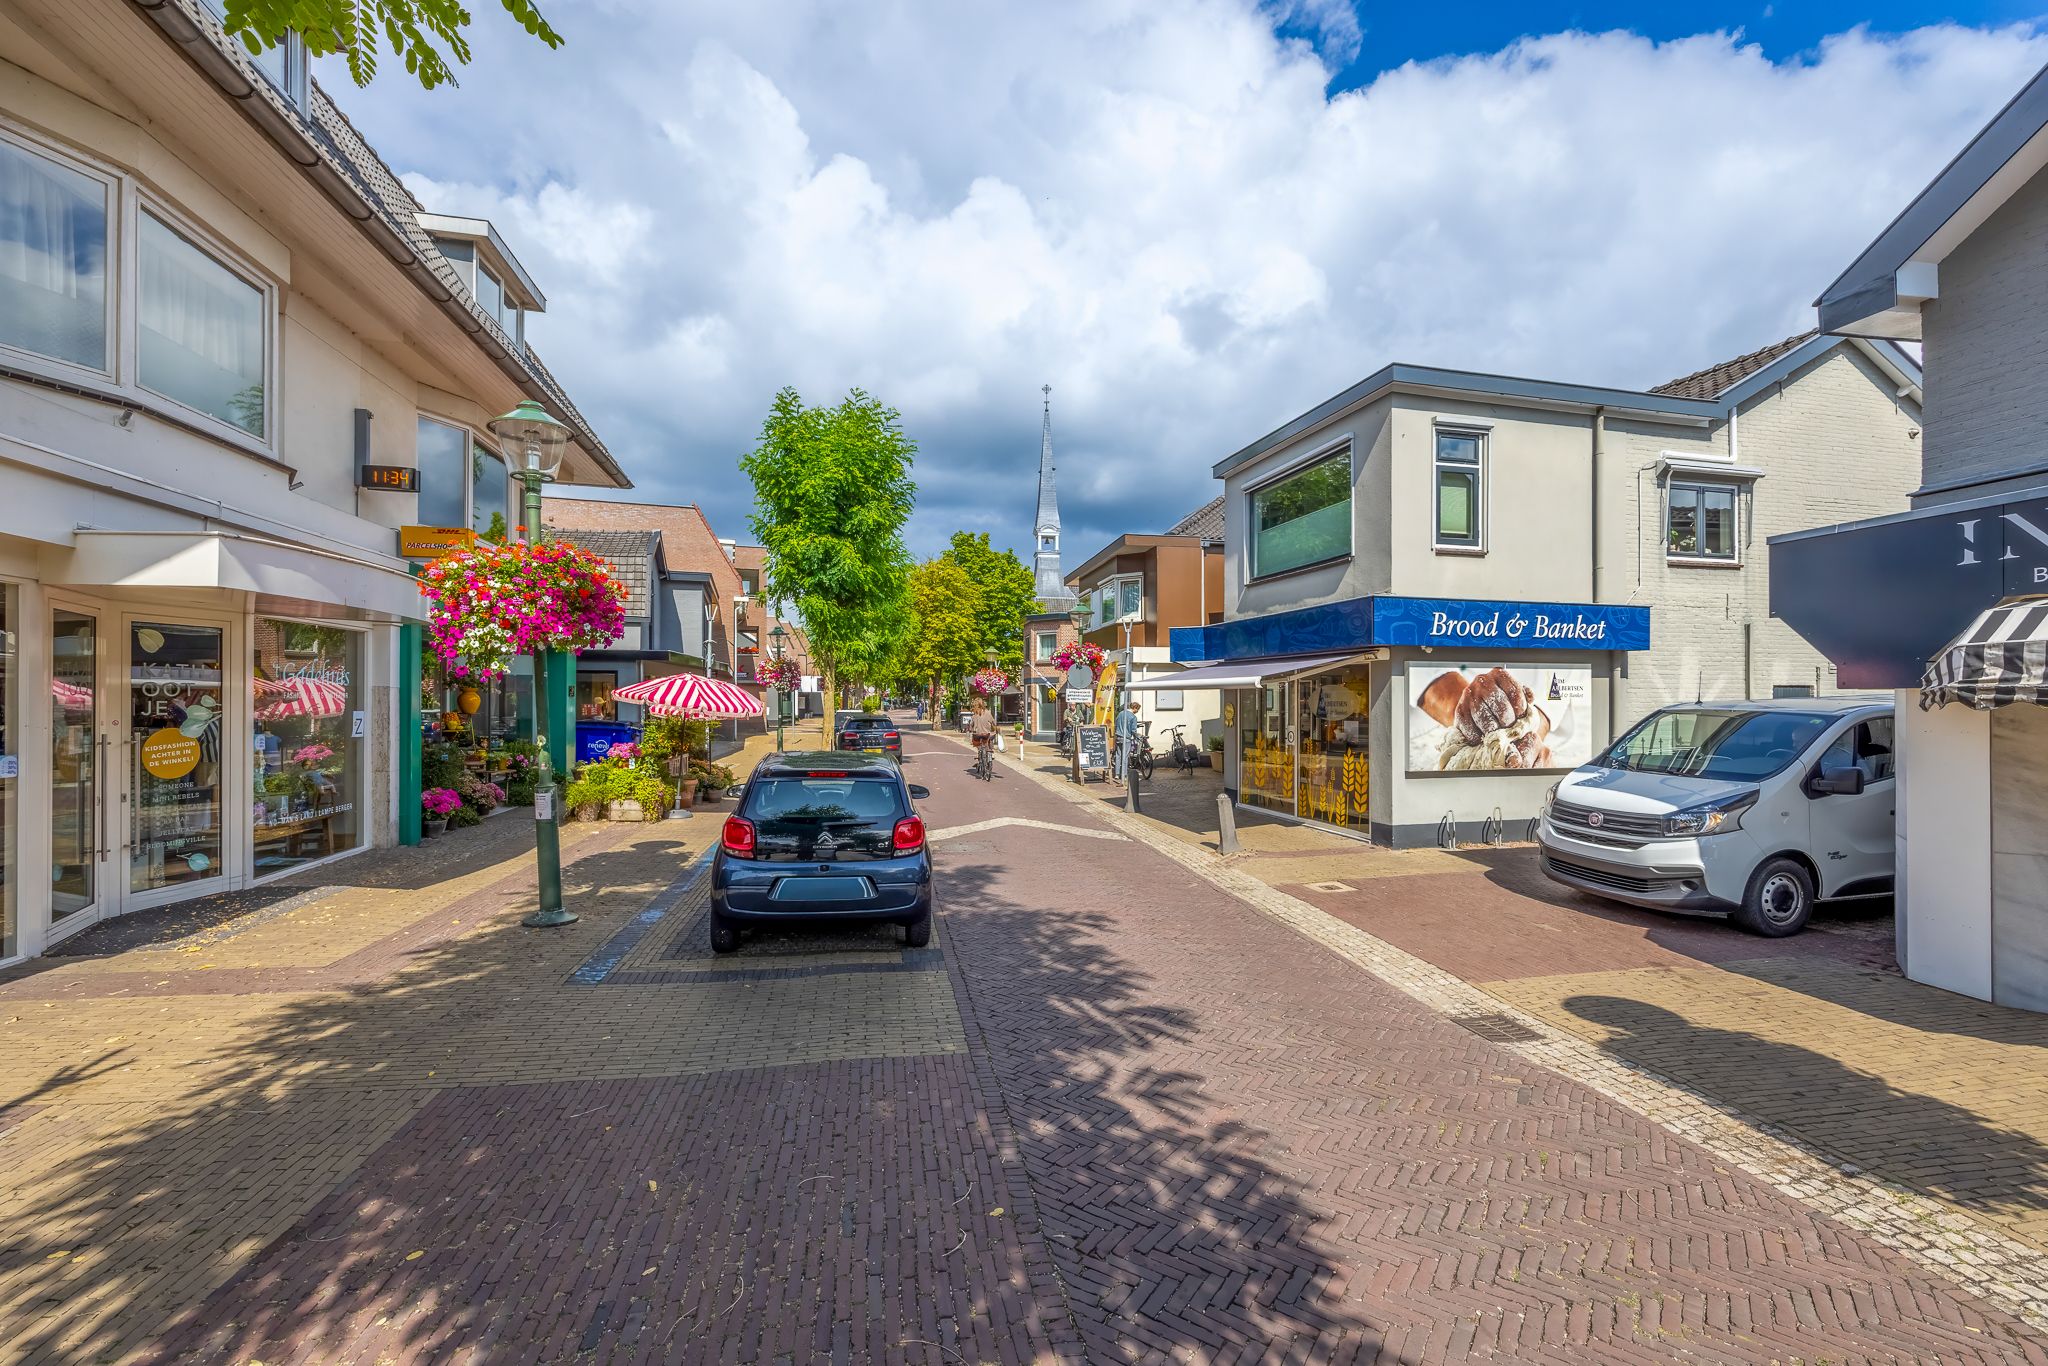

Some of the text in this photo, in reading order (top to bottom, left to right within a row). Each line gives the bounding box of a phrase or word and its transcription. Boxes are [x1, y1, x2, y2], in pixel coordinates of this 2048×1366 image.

[373, 469, 409, 485] 11:34
[1429, 611, 1607, 640] Brood & Banket
[141, 700, 168, 716] JE
[145, 741, 196, 752] KIDSFASHION
[151, 750, 181, 759] ACHTER
[162, 756, 194, 765] WINKEL!
[172, 792, 200, 800] REBELS
[318, 806, 334, 817] LAMPE
[335, 803, 353, 813] BERGER
